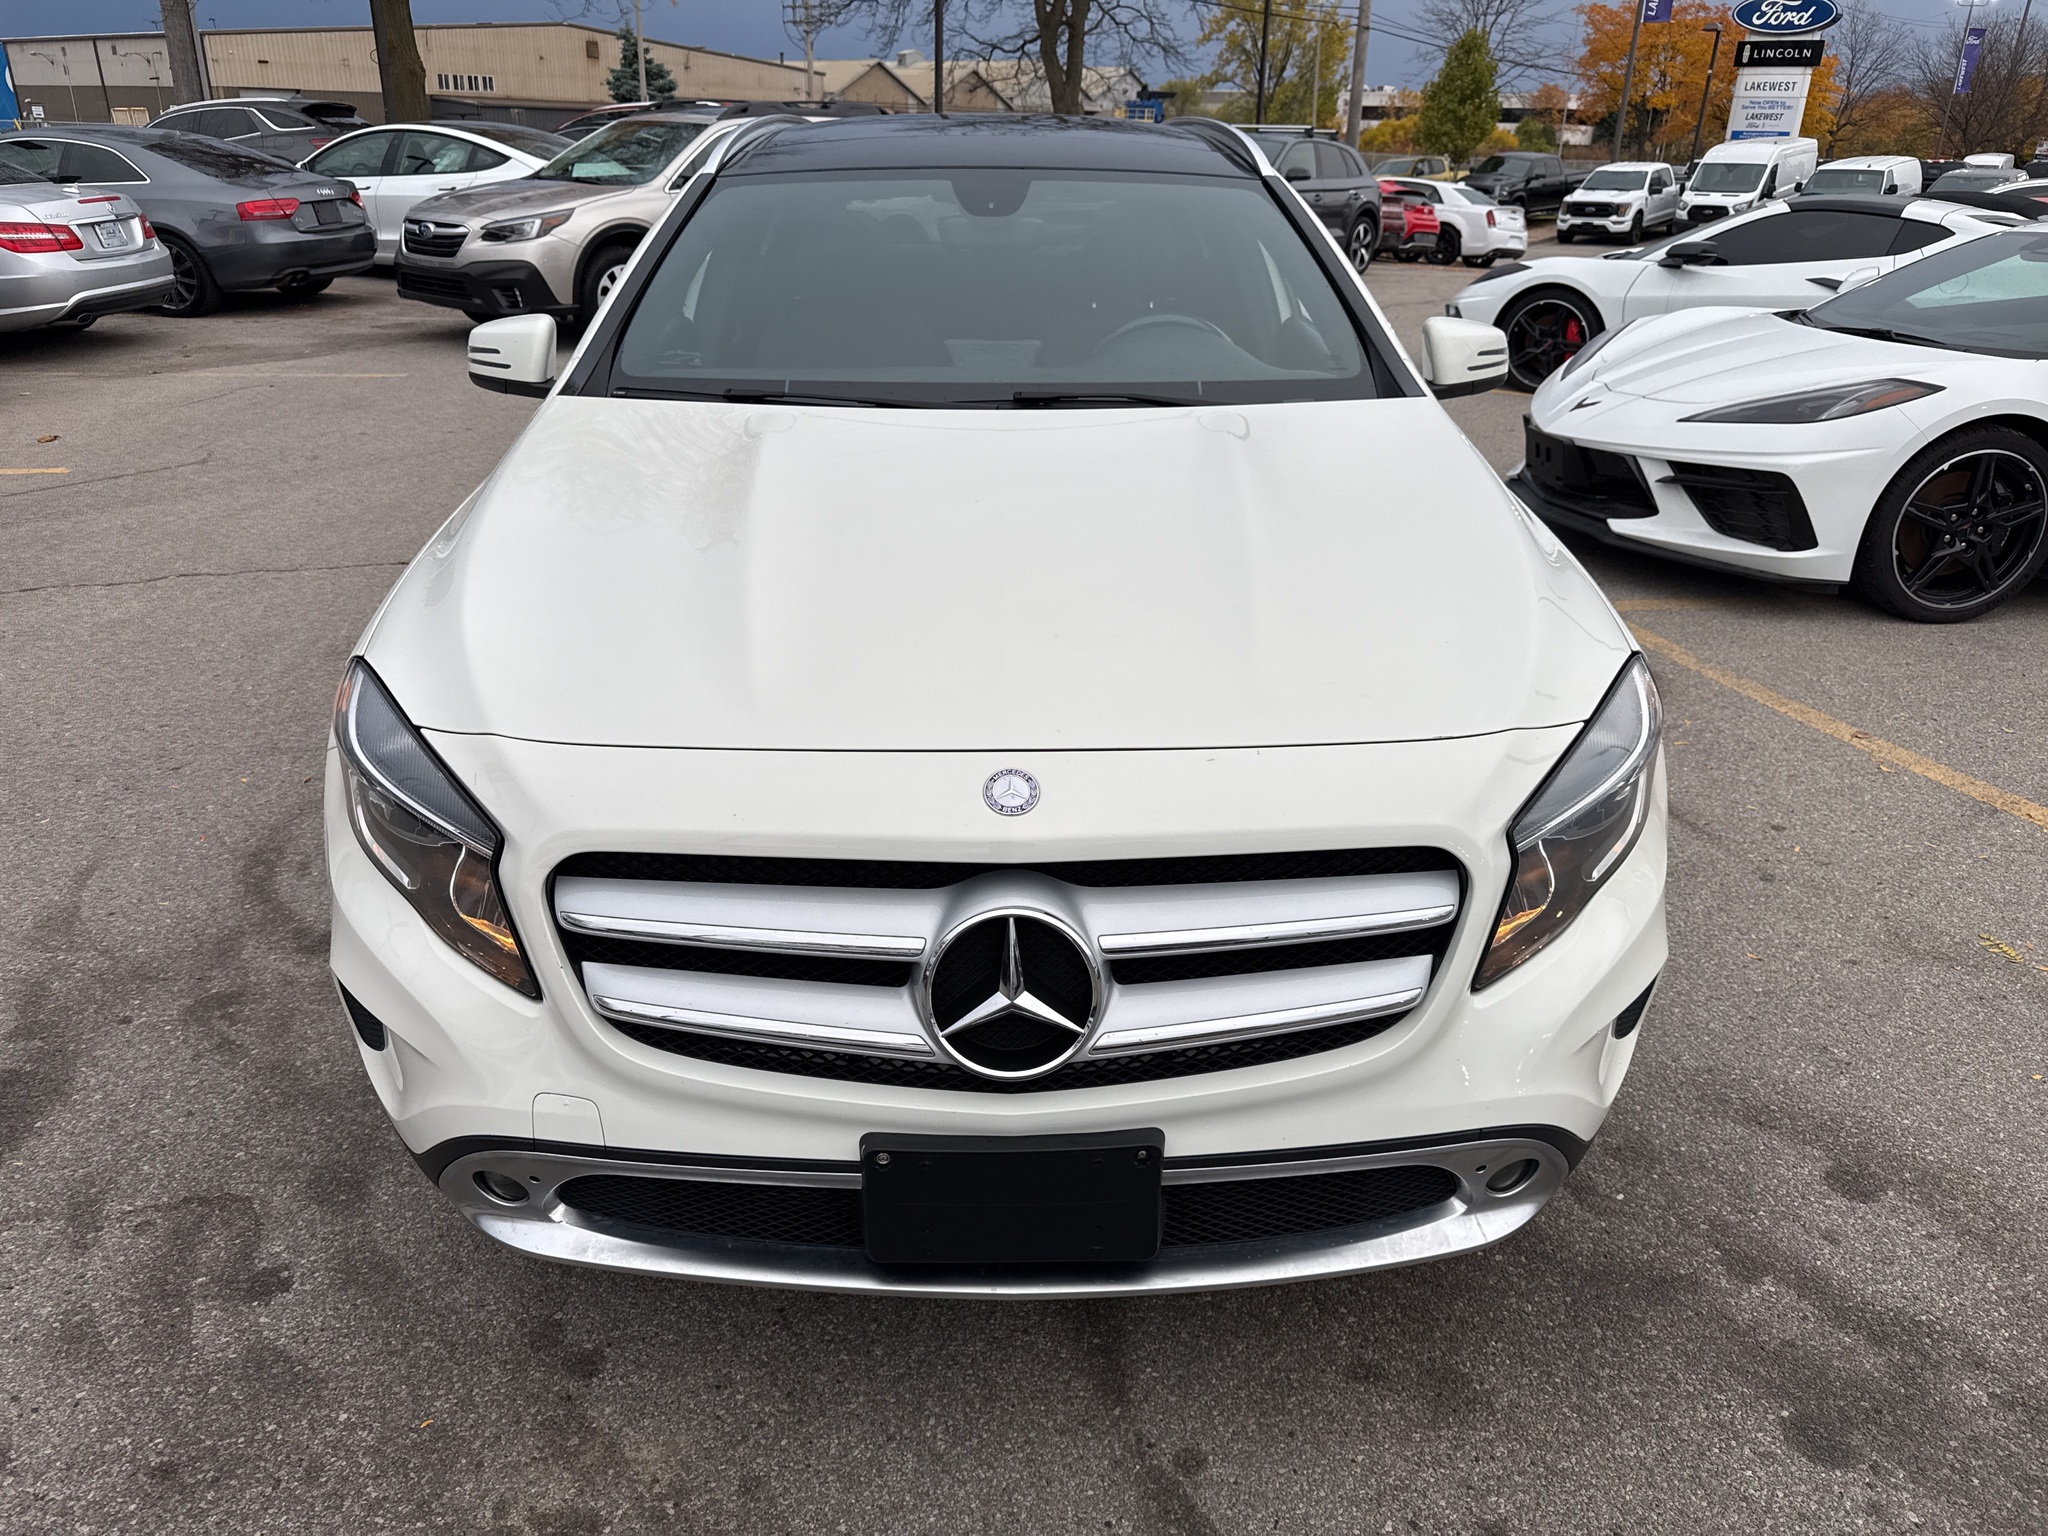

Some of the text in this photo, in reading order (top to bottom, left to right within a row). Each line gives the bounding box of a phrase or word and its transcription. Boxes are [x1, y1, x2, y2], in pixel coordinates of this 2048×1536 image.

[1752, 0, 1817, 26] Ford
[1753, 48, 1812, 58] LINCOLN
[1744, 81, 1798, 92] LAKEWEST
[1745, 112, 1785, 121] LAKEWEST
[993, 769, 1030, 780] MERCEDES
[1002, 806, 1022, 814] BENZ
